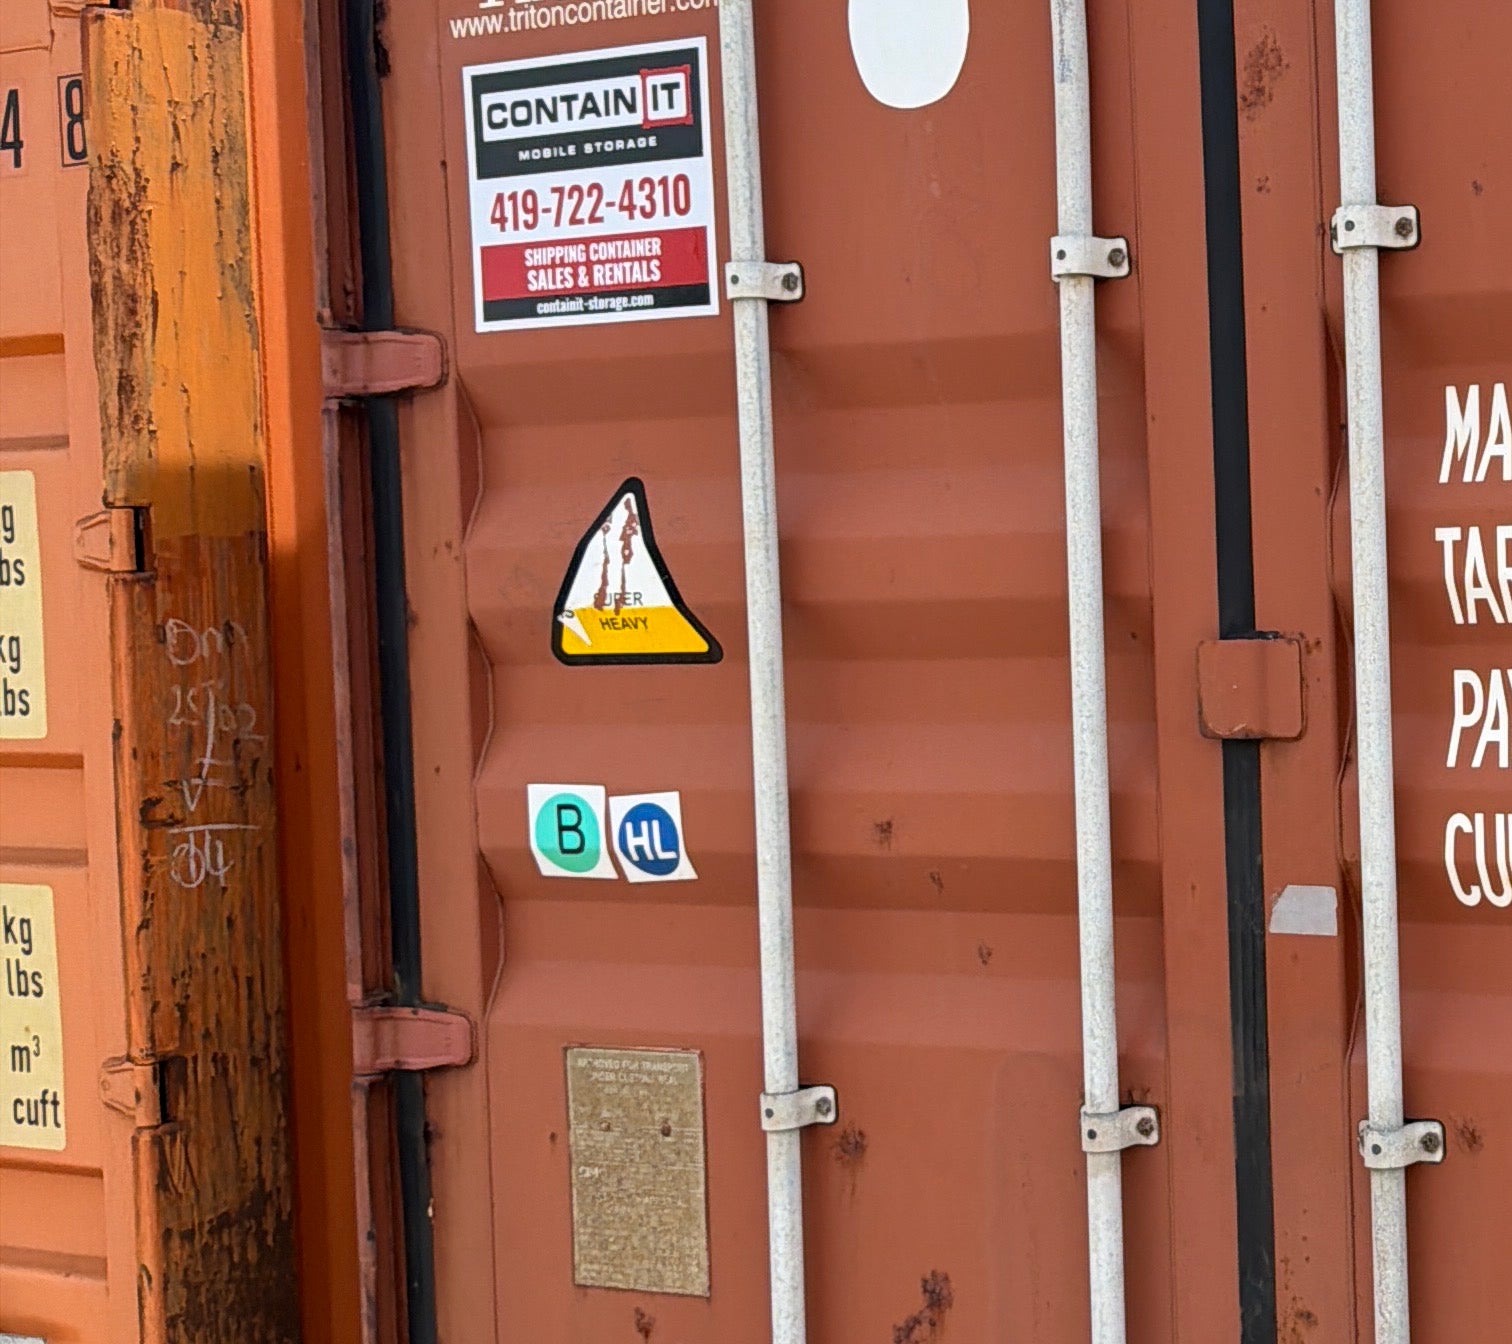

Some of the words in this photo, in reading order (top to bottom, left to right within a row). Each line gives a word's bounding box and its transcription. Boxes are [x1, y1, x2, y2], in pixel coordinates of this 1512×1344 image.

[487, 87, 637, 130] CONTAIN
[652, 82, 680, 111] IT
[519, 144, 576, 161] MOBILE
[584, 136, 657, 154] STORAGE
[490, 173, 691, 232] 419-722-4310
[524, 243, 586, 266] SHIPPING
[590, 237, 661, 261] CONTAINER
[527, 266, 573, 291] SALES
[578, 266, 589, 286] &
[593, 259, 661, 286] RENTALS
[537, 294, 654, 314] containit-storage.com
[599, 616, 648, 630] HEAVY
[556, 804, 586, 854] B
[625, 819, 677, 862] HL
[2, 905, 32, 955] kg
[6, 958, 44, 997] lbs
[13, 1089, 61, 1128] cuft
